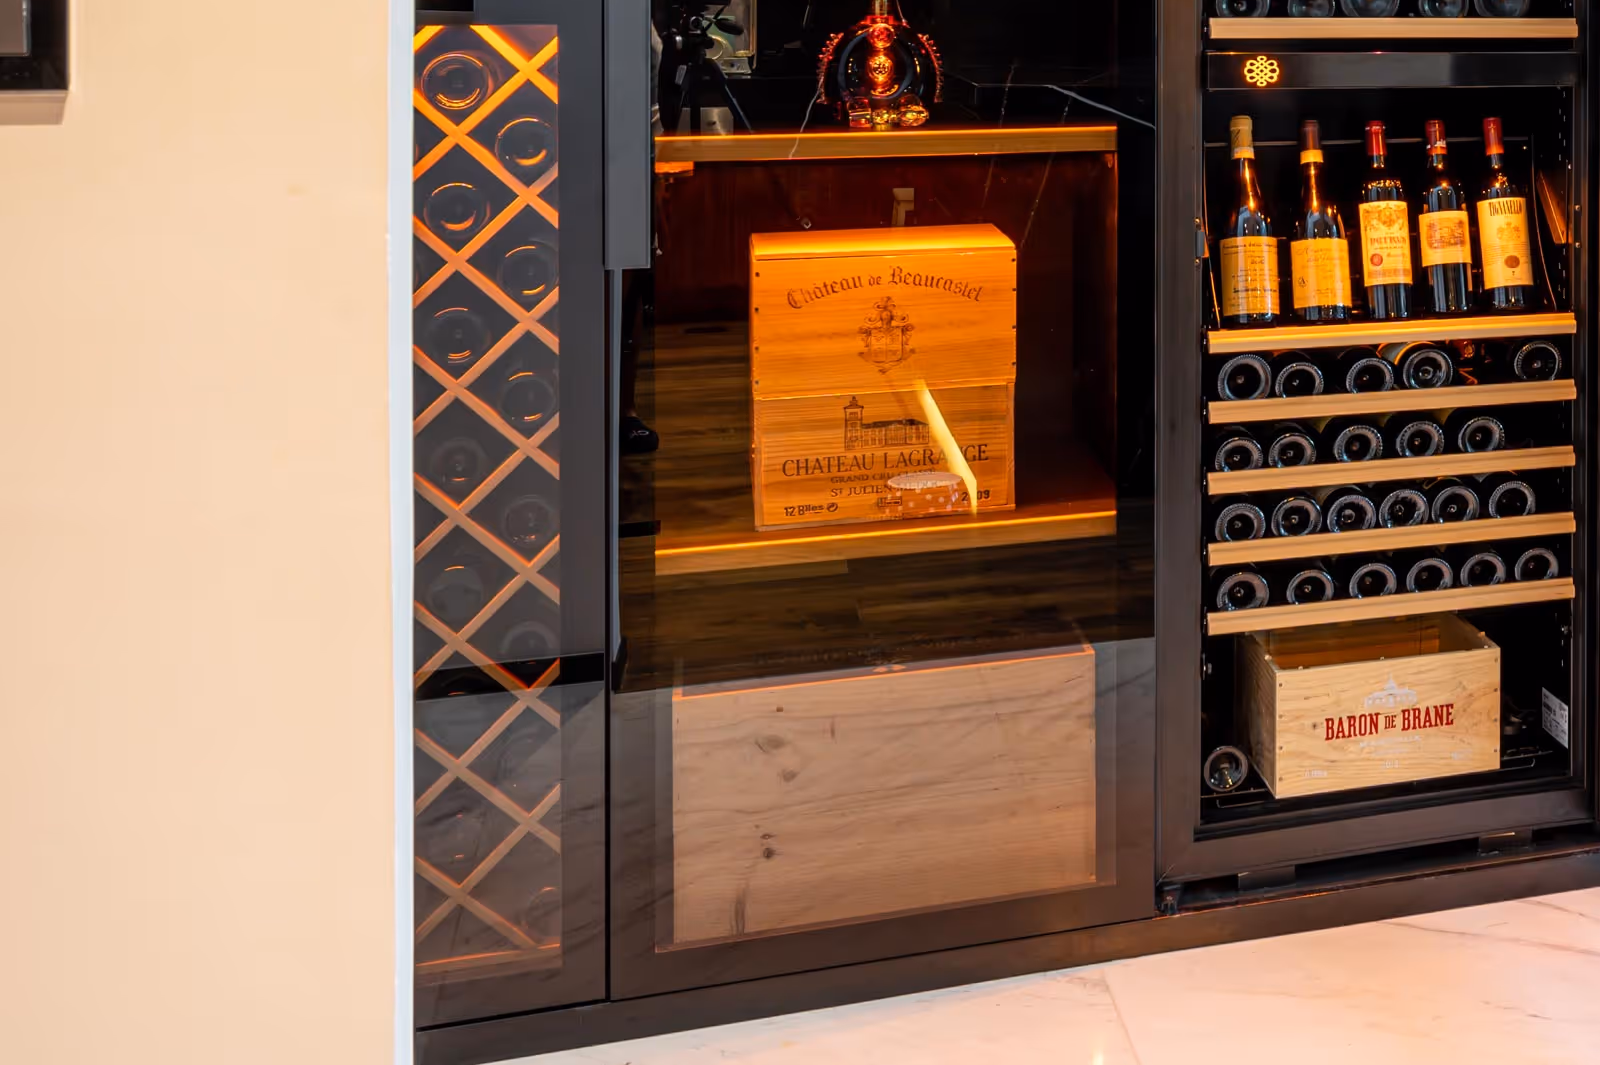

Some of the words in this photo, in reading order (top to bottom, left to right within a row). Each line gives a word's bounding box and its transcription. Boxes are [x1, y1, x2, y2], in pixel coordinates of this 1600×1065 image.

[868, 274, 882, 286] de
[888, 266, 984, 302] Beaucastel
[884, 443, 989, 469] LAGRAGE
[961, 489, 990, 502] 209
[1325, 712, 1380, 741] BARON
[1384, 714, 1397, 730] DE
[1401, 703, 1455, 731] BRANE
